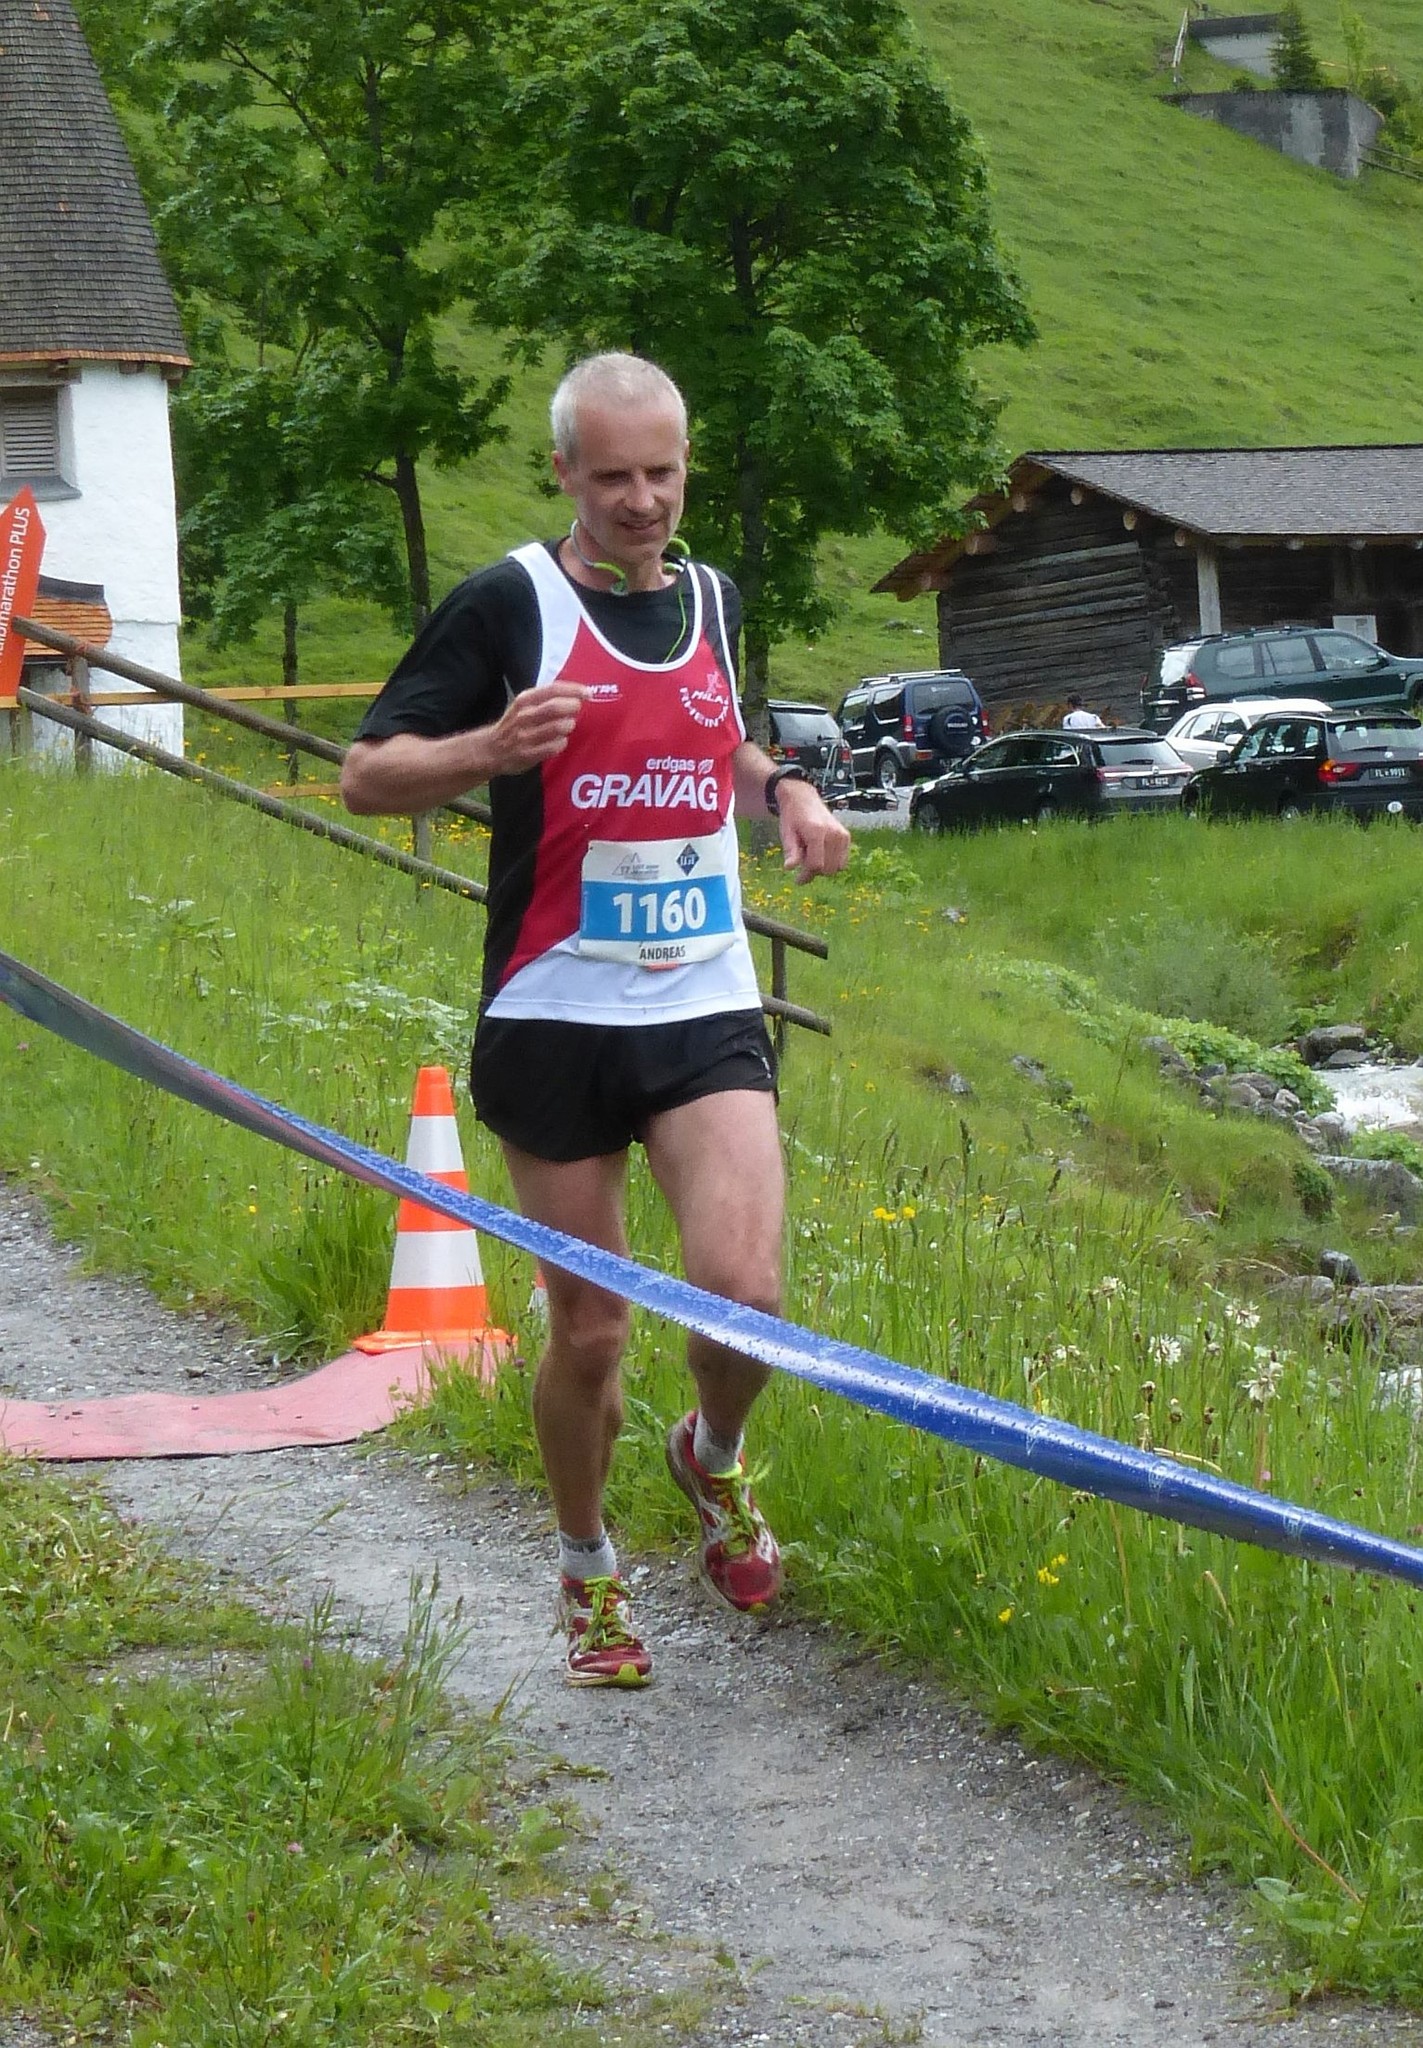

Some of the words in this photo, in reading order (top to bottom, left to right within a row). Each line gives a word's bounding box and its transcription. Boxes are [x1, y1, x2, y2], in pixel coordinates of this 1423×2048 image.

[9, 507, 31, 545] PLUS
[645, 756, 696, 774] erdgas
[571, 773, 718, 811] GRAVAG
[612, 886, 707, 934] 1160
[639, 944, 686, 961] ANDREAS
